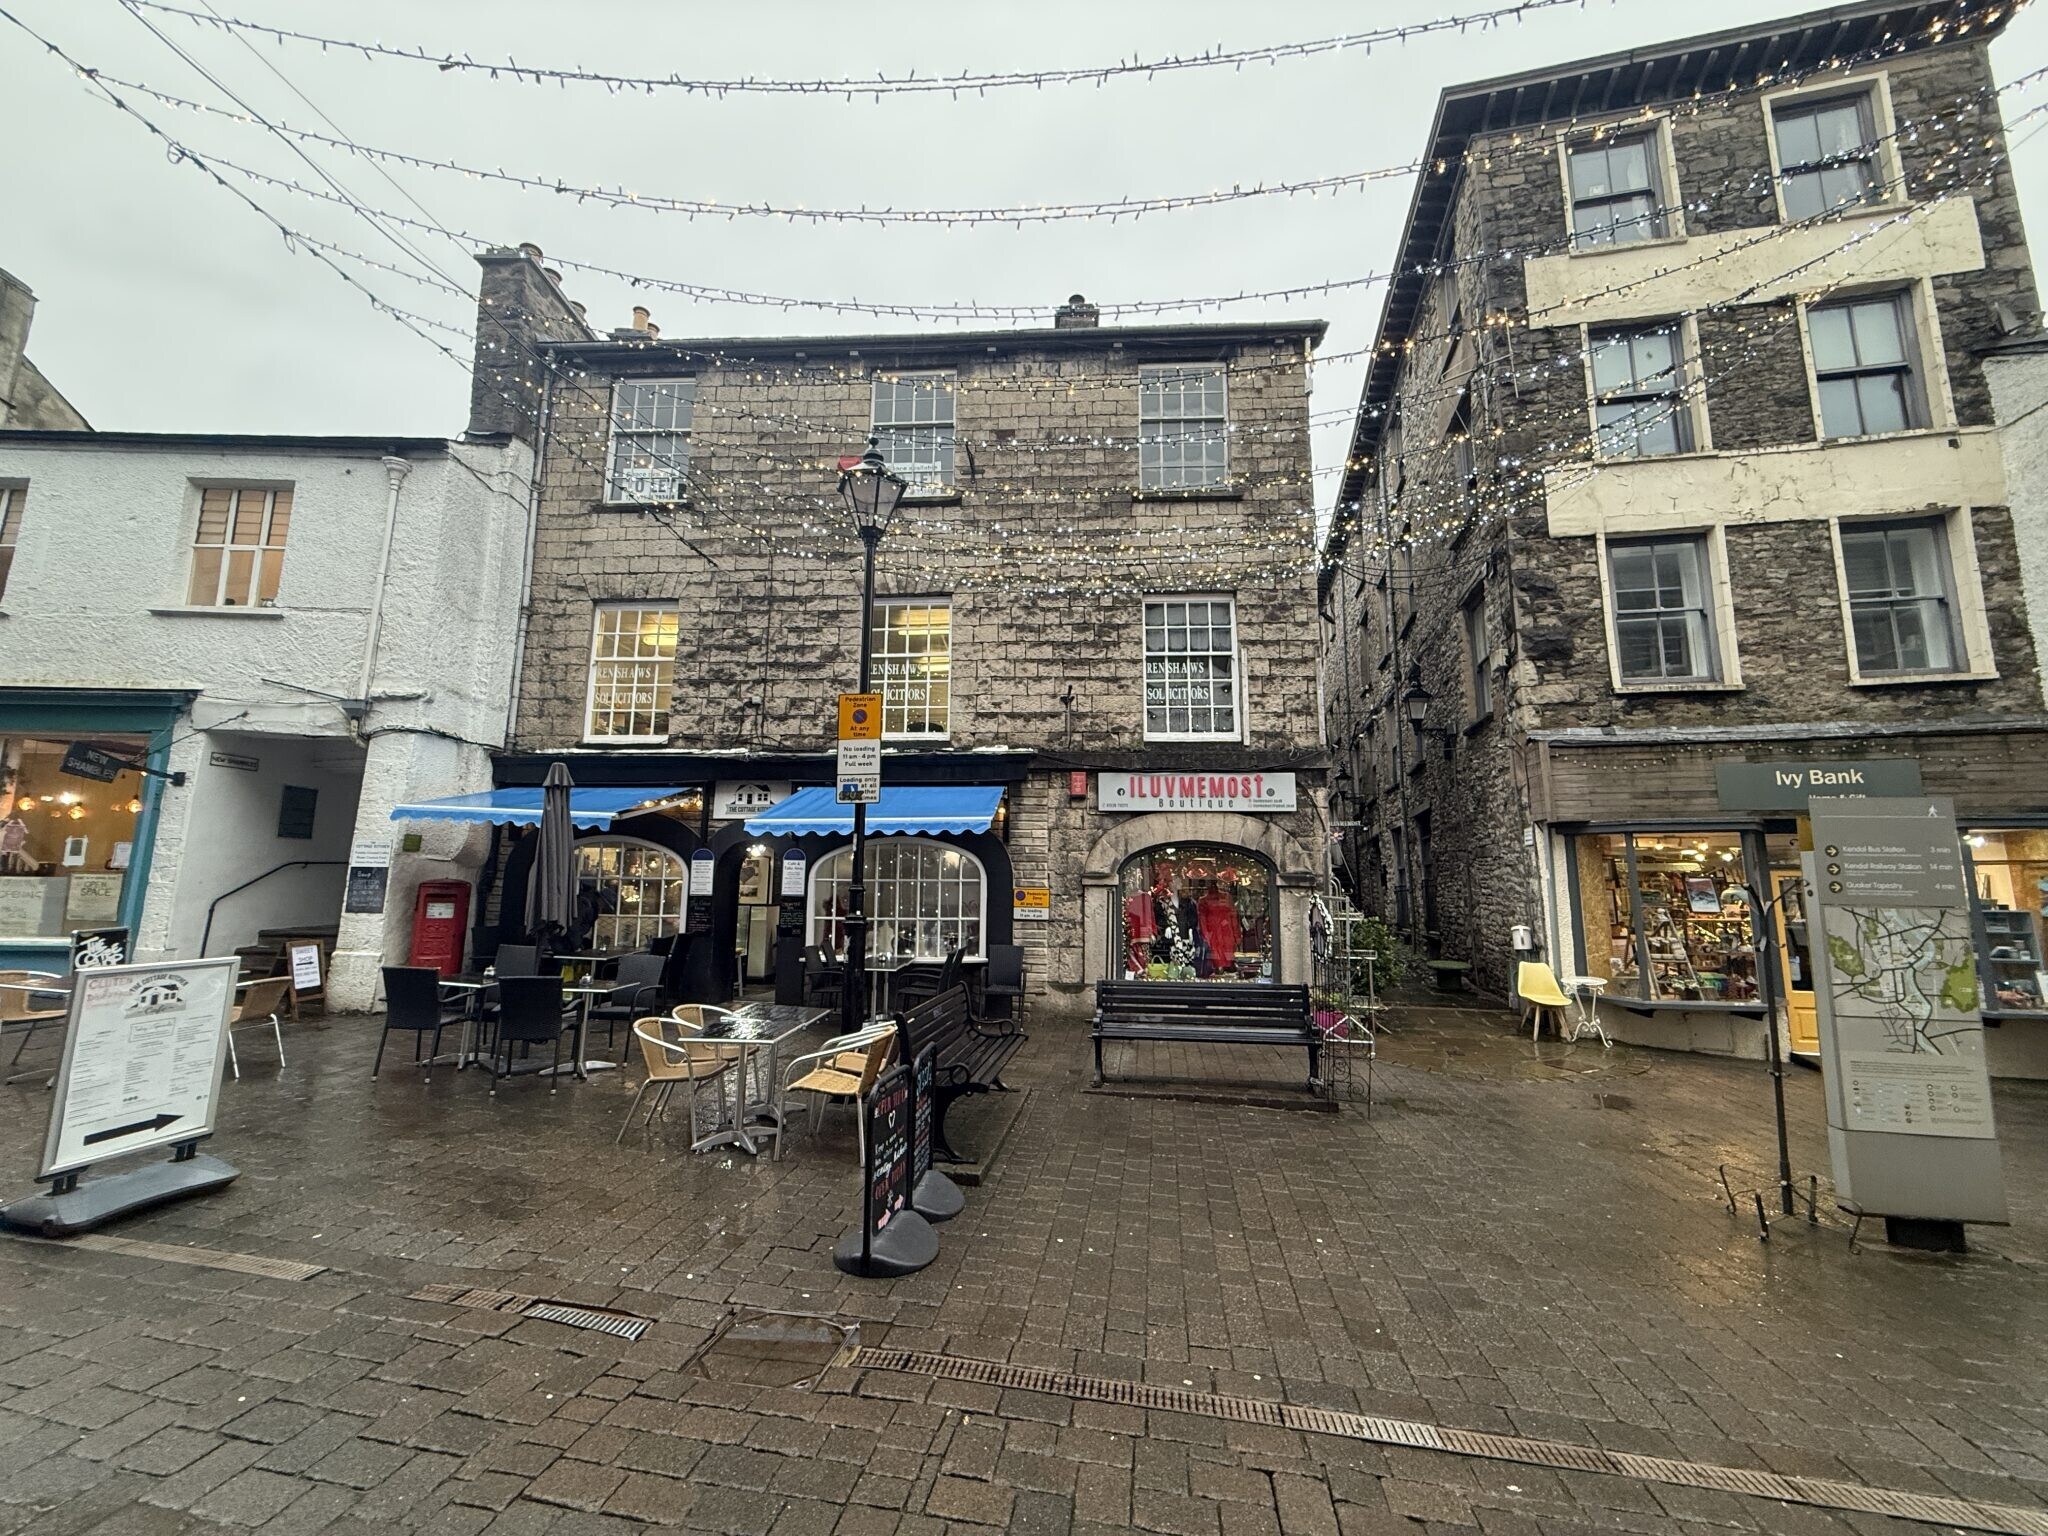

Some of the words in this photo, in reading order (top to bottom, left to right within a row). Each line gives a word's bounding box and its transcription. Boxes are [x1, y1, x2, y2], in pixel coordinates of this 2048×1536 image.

[598, 667, 651, 679] RENSHAWS
[1146, 662, 1204, 674] RENSHAWS
[595, 691, 653, 704] SOLICITORS
[1147, 687, 1209, 700] SOLICITORS
[1775, 770, 1803, 789] Ivy
[1809, 768, 1865, 785] Bank
[1129, 774, 1264, 798] ILUVMEMOST
[1158, 798, 1234, 809] Boutique
[1842, 845, 1867, 853] Kendal
[1870, 863, 1897, 871] Railway
[1846, 881, 1872, 889] Quaker
[1873, 881, 1903, 890] Tapestry
[80, 888, 113, 897] SPACE
[141, 973, 169, 985] COTTAGE
